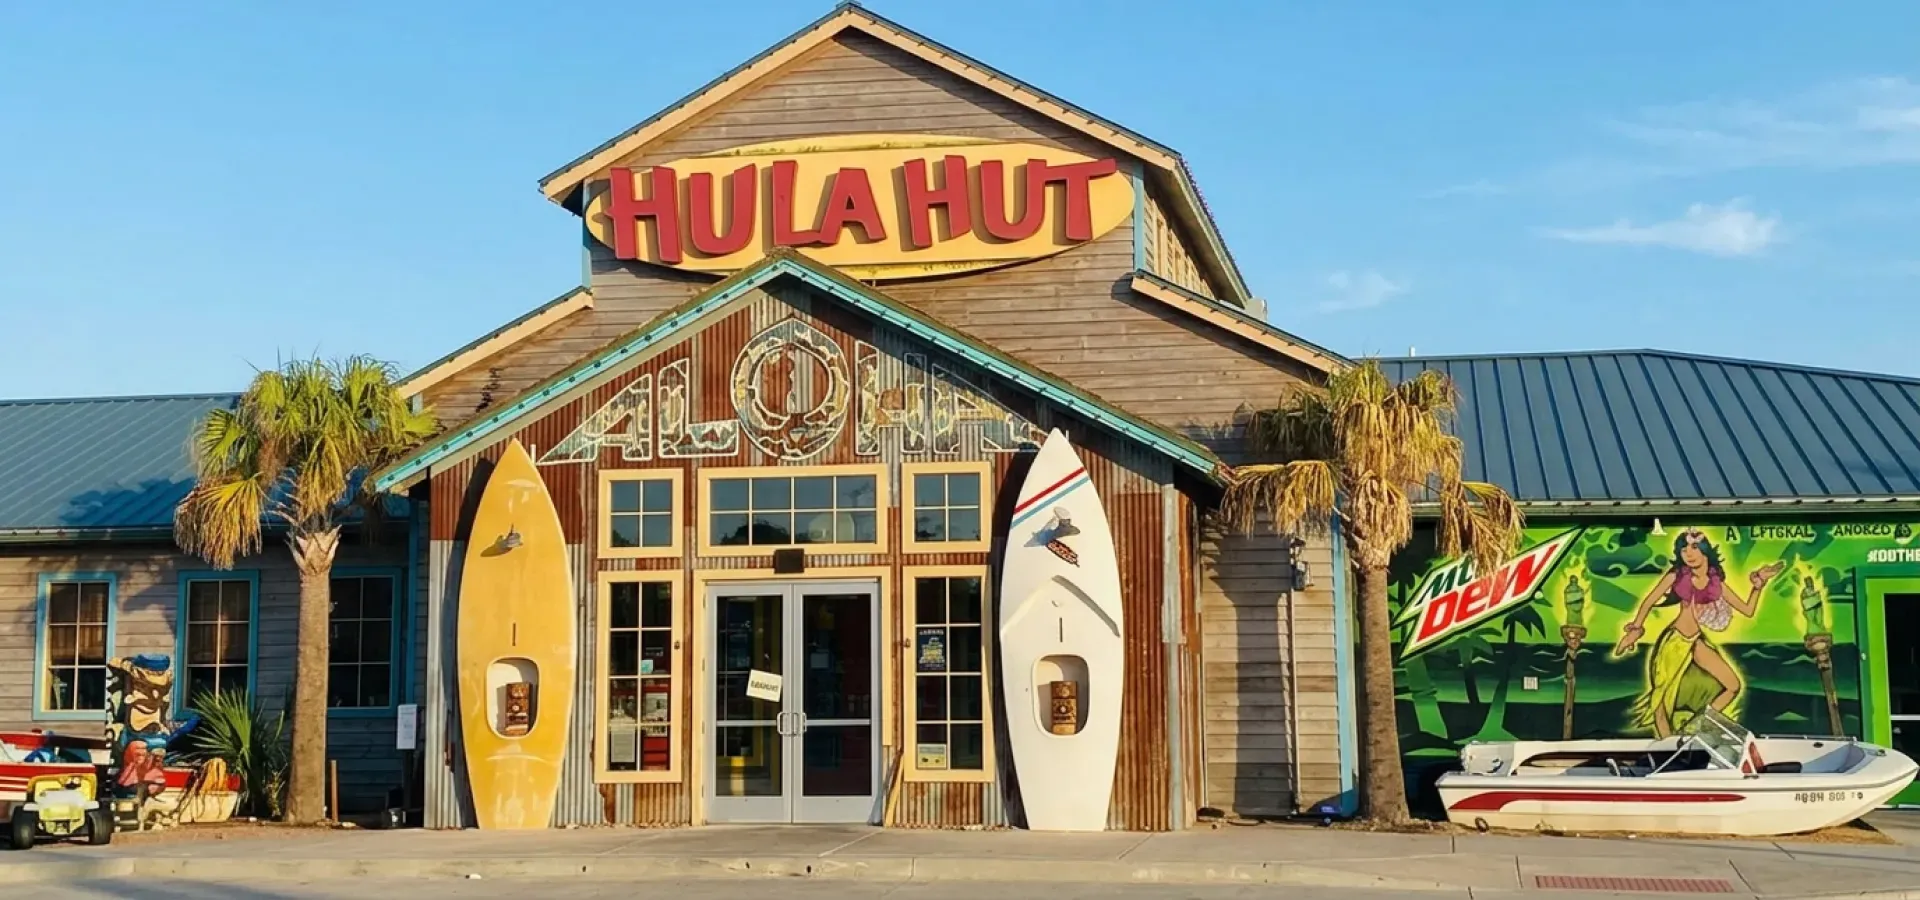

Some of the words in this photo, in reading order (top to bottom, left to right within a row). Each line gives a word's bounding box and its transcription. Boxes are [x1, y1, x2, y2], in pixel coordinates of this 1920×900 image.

[604, 159, 887, 265] HULA
[903, 154, 1117, 248] HUT
[536, 317, 1046, 461] ALOHA
